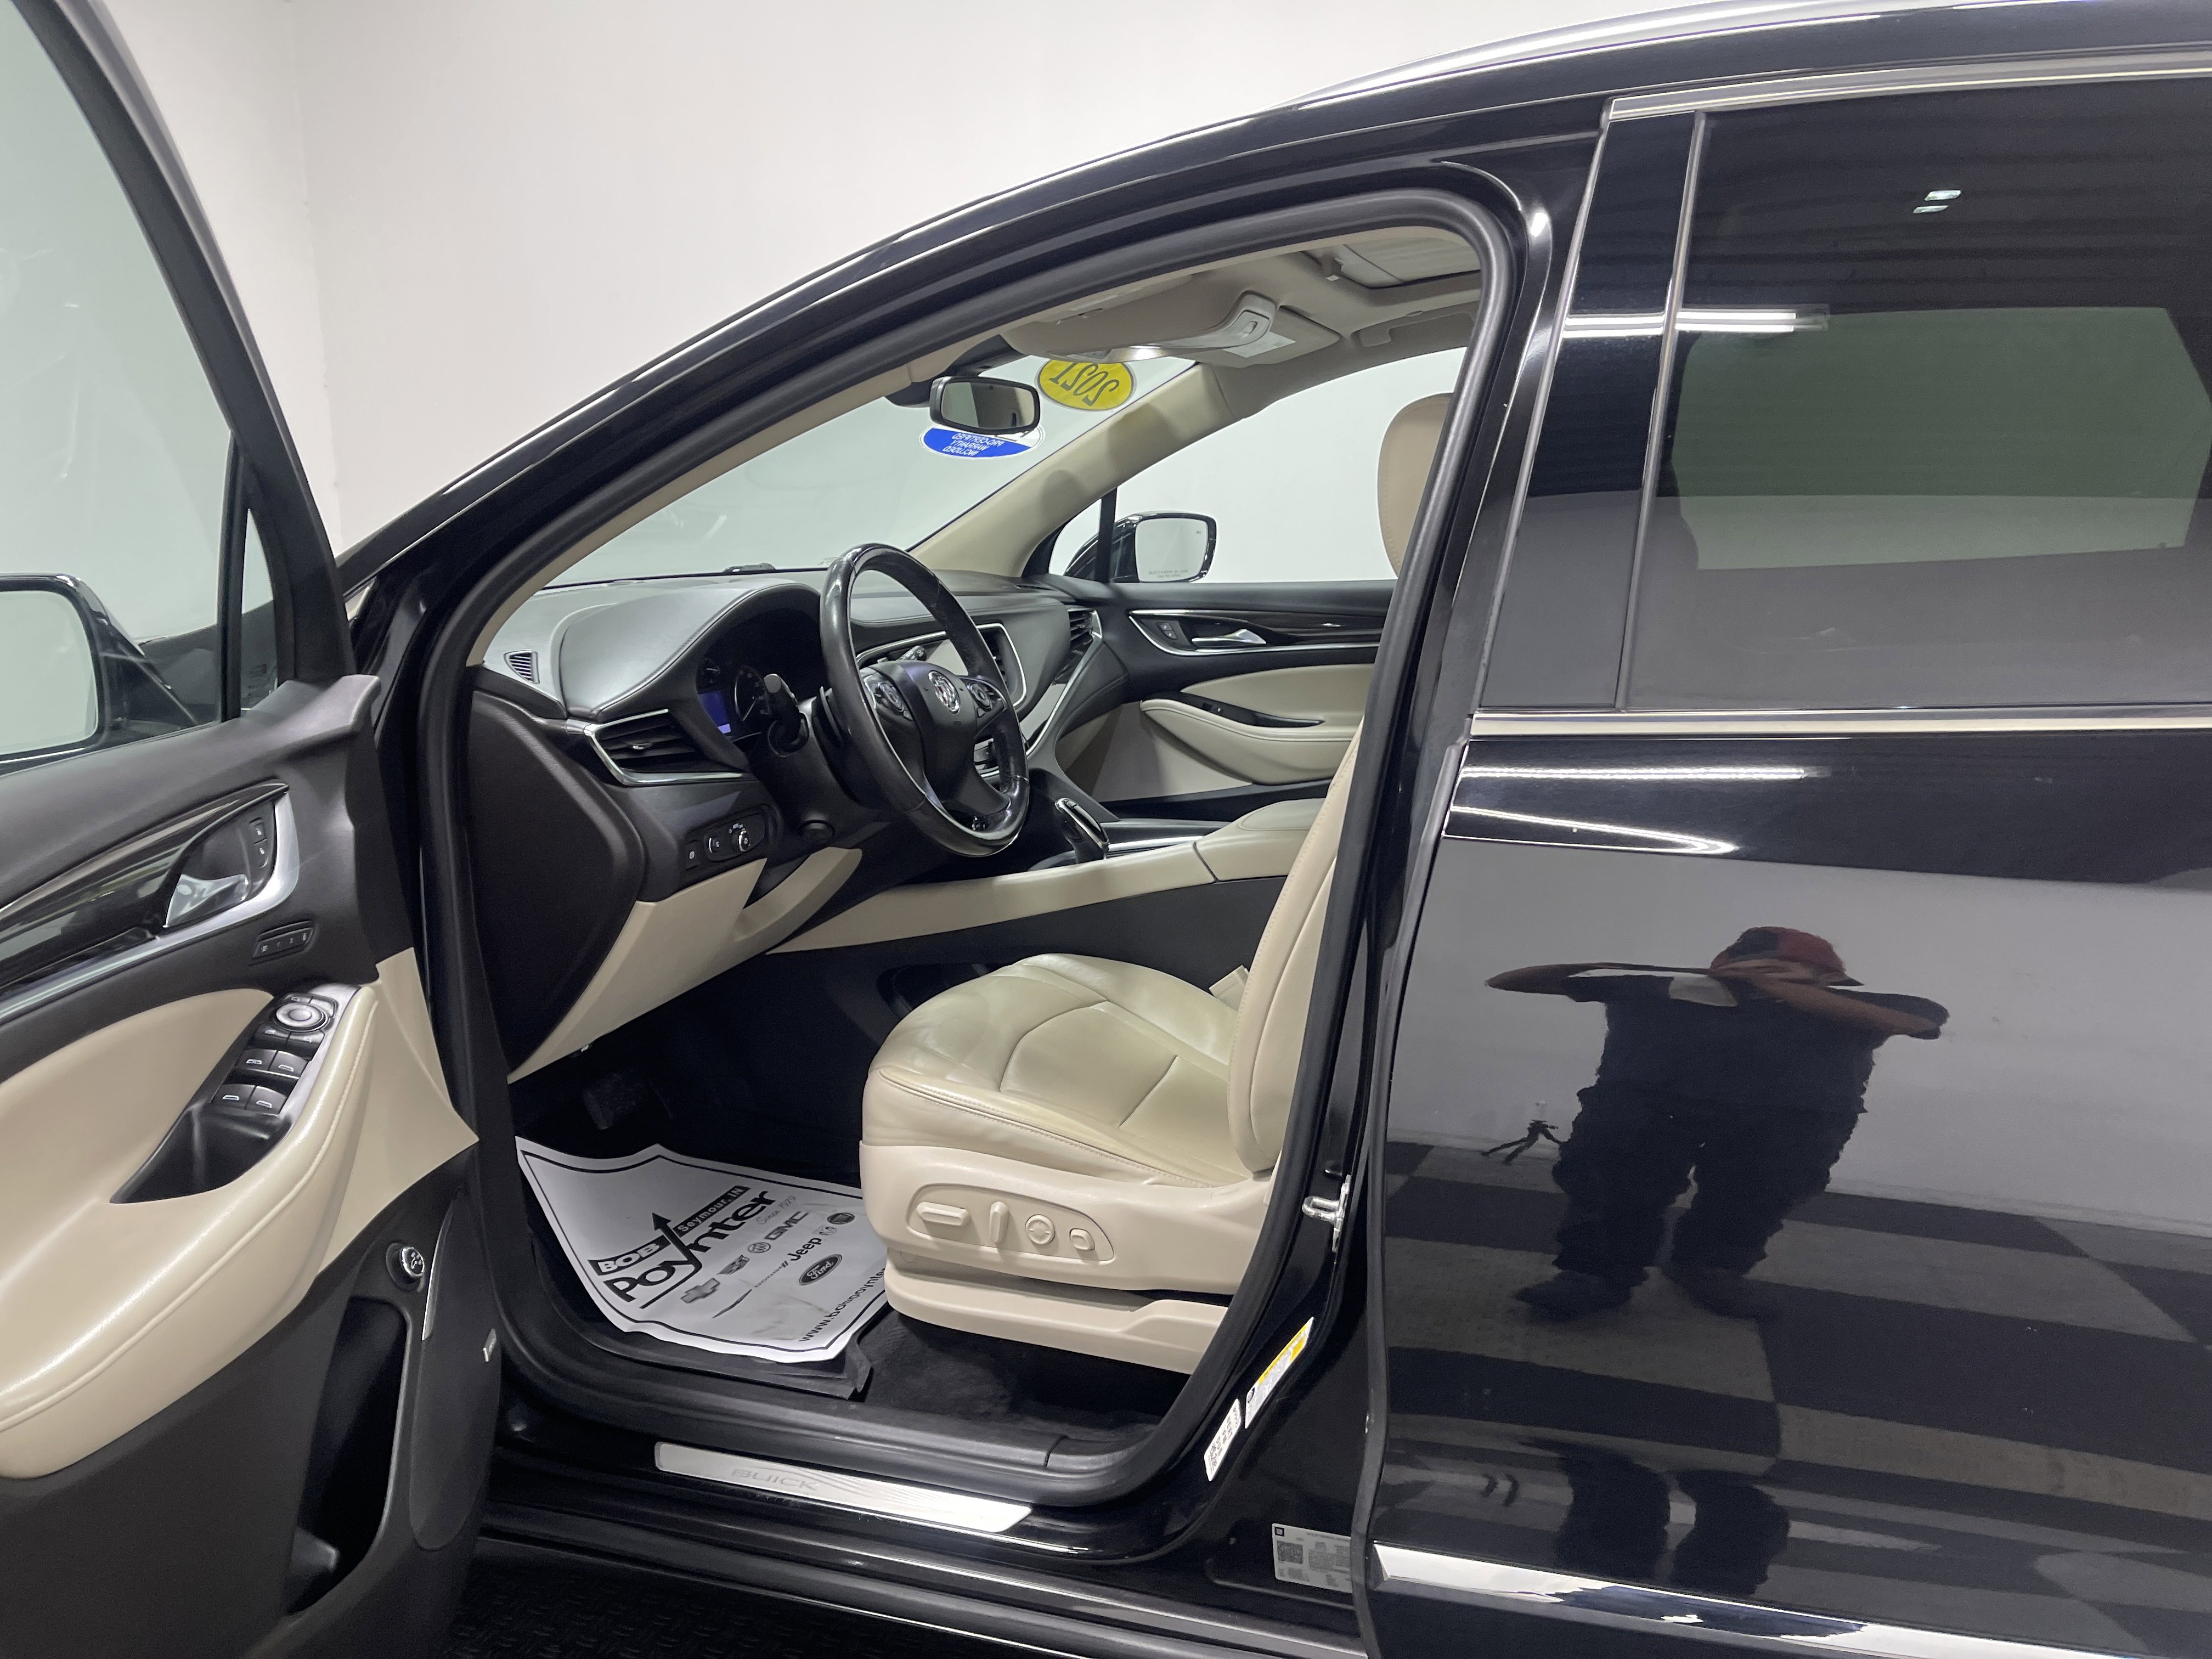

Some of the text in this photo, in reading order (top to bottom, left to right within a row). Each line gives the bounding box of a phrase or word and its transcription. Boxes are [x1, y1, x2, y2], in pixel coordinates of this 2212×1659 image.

[727, 1188, 744, 1198] IN
[756, 1196, 796, 1225] Since 1979
[764, 1211, 809, 1240] GMC
[597, 1243, 661, 1273] BOB
[787, 1238, 822, 1261] Jeep
[806, 1261, 834, 1280] Ford
[732, 1468, 820, 1491] BUICK
